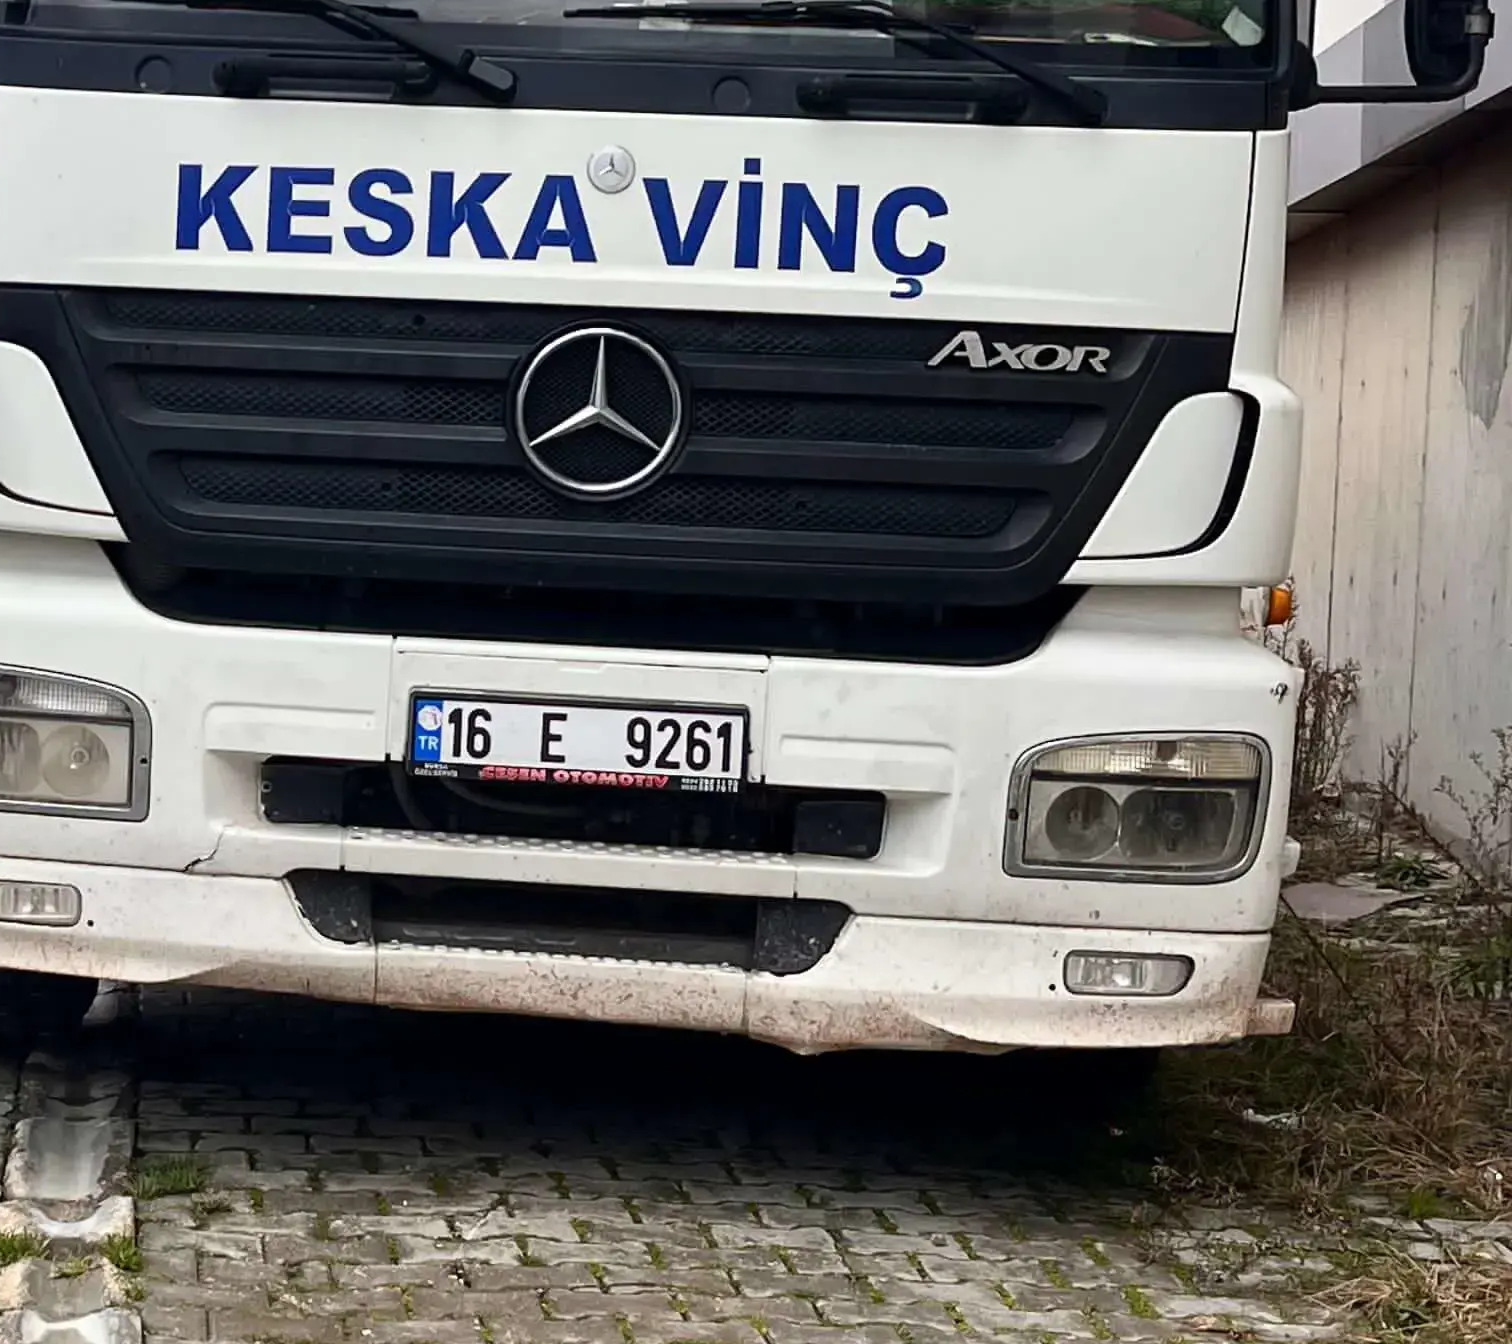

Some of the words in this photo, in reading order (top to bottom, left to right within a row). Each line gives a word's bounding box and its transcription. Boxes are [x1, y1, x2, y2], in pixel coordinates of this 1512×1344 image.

[175, 163, 598, 264] KESKA
[642, 158, 950, 299] VİNÇ
[419, 736, 439, 750] TR
[448, 708, 493, 759] 16
[540, 713, 568, 763] E
[624, 716, 733, 772] 9261
